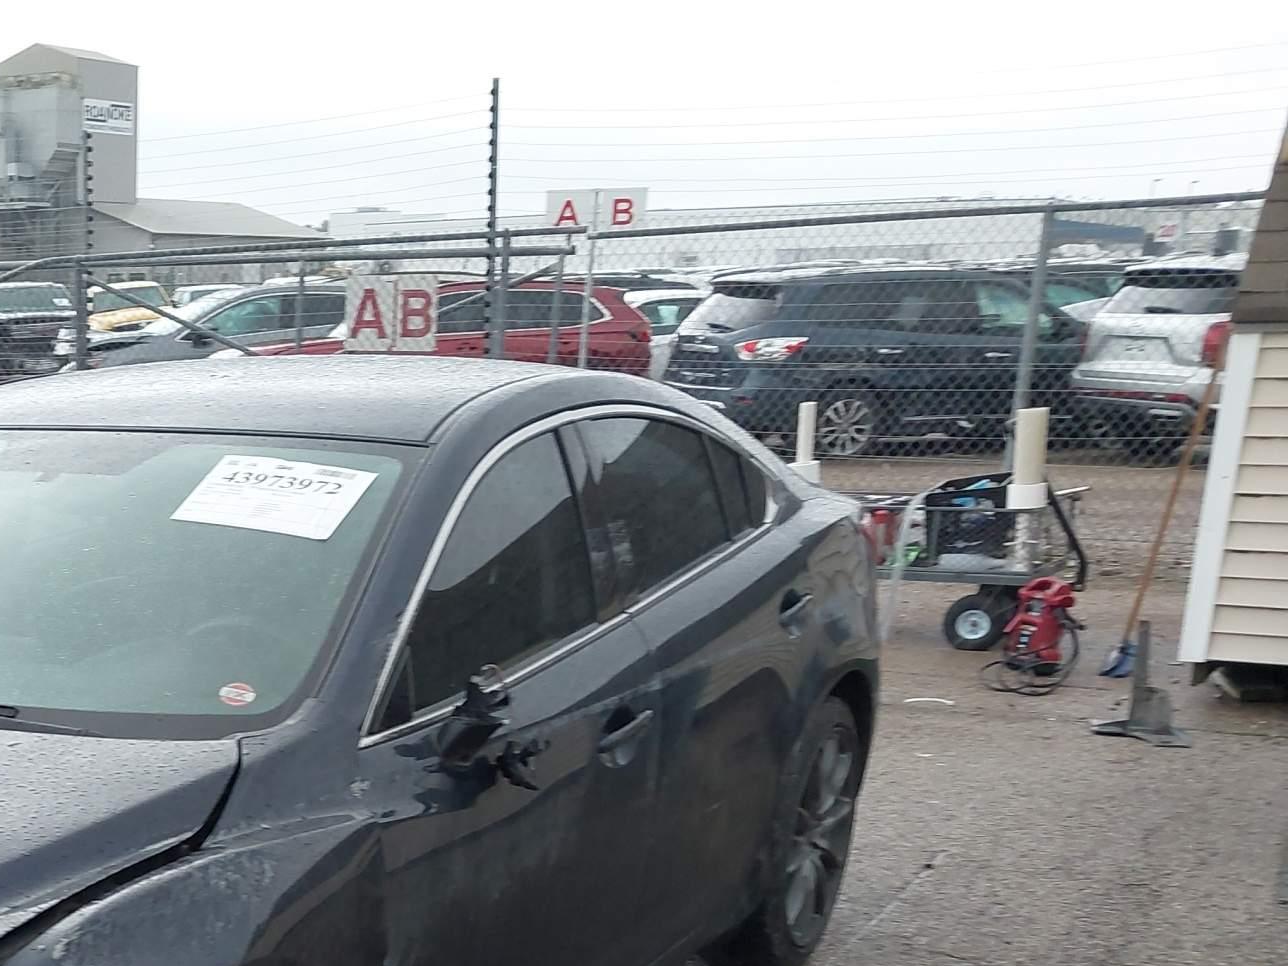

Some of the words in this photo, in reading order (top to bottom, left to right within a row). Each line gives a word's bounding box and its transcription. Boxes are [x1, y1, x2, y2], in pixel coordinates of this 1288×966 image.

[555, 199, 580, 227] A
[612, 198, 634, 226] B
[222, 470, 342, 495] 43973972
